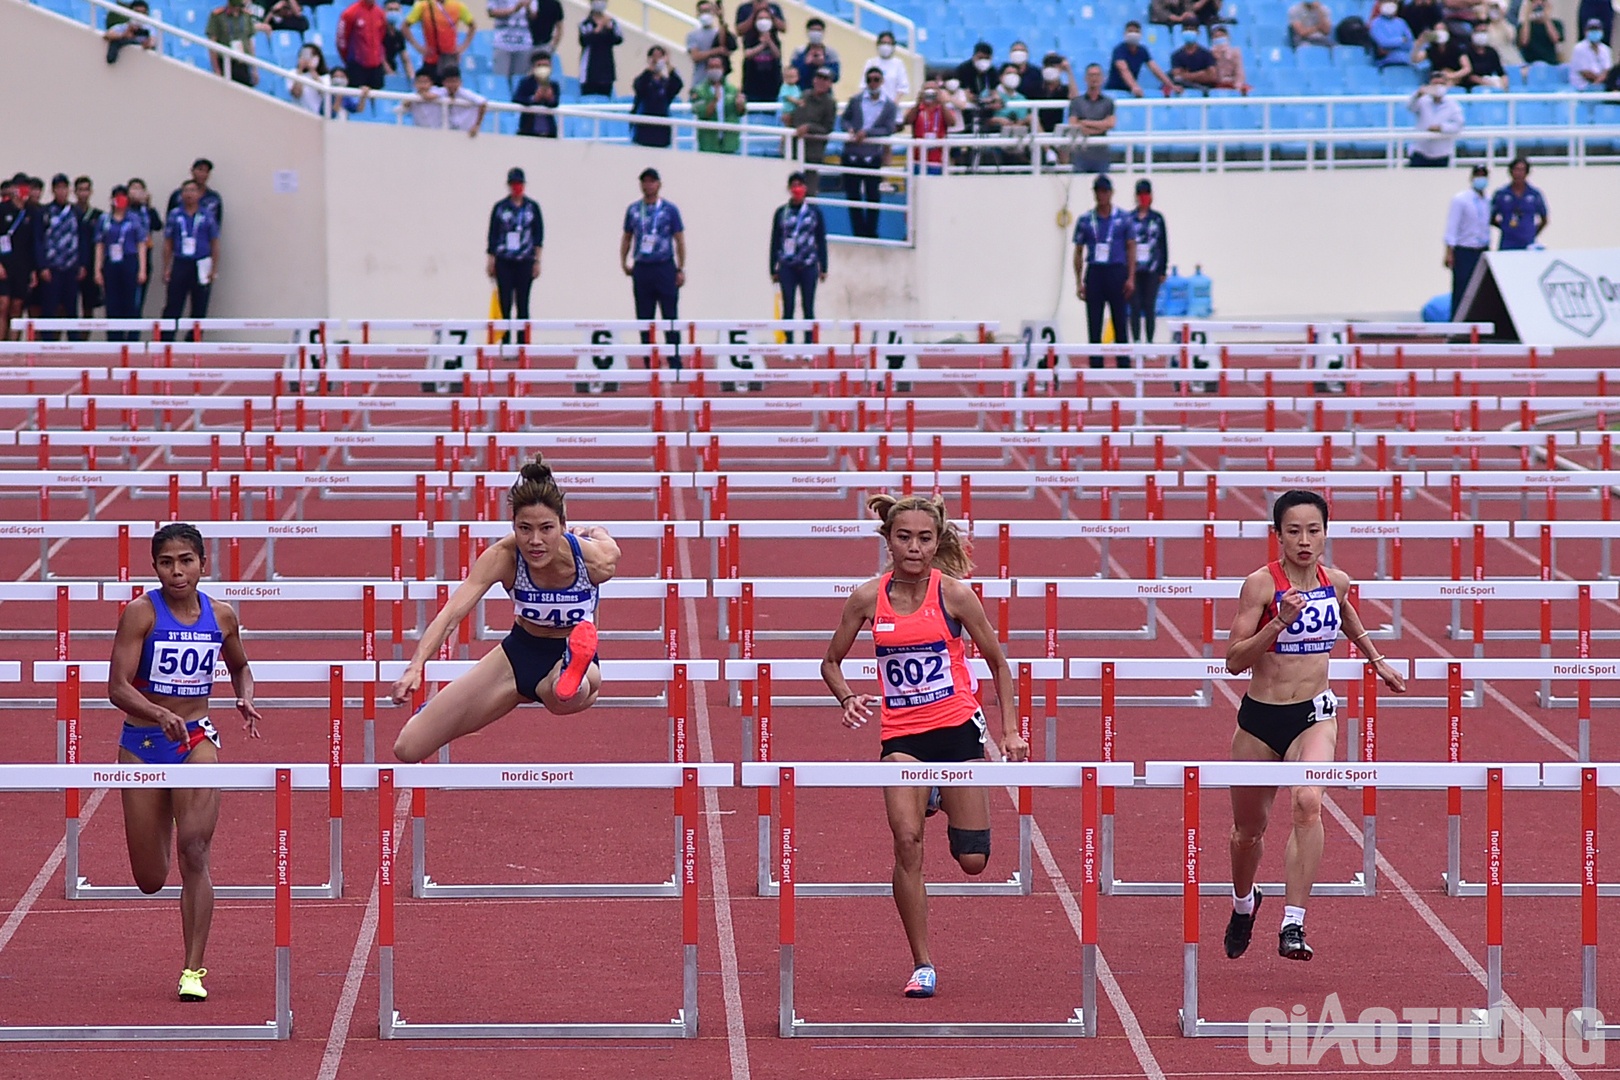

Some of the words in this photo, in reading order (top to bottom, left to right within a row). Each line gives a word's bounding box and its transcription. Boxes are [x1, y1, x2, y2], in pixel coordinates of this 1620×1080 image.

[22, 526, 44, 534] Sport
[296, 526, 318, 534] Sport
[838, 524, 860, 534] Sport
[1108, 525, 1130, 534] Sport
[1378, 526, 1400, 534] Sport
[256, 586, 280, 597] Sport
[1168, 585, 1192, 594] Sport
[1470, 586, 1495, 596] Sport
[158, 648, 214, 675] 504
[886, 656, 944, 687] 602
[1588, 664, 1616, 676] Sport
[910, 693, 934, 705] VIETNAM
[332, 746, 340, 767] Sport
[134, 771, 166, 784] Sport
[541, 771, 573, 784] Sport
[941, 769, 973, 782] Sport
[1345, 769, 1377, 782] Sport
[278, 860, 287, 885] Sport
[380, 861, 390, 885] Sport
[685, 859, 694, 884] Sport
[781, 858, 791, 883] Sport
[1084, 858, 1094, 883] Sport
[1186, 859, 1196, 884] Sport
[1490, 861, 1499, 885] Sport
[1584, 860, 1594, 885] Sport
